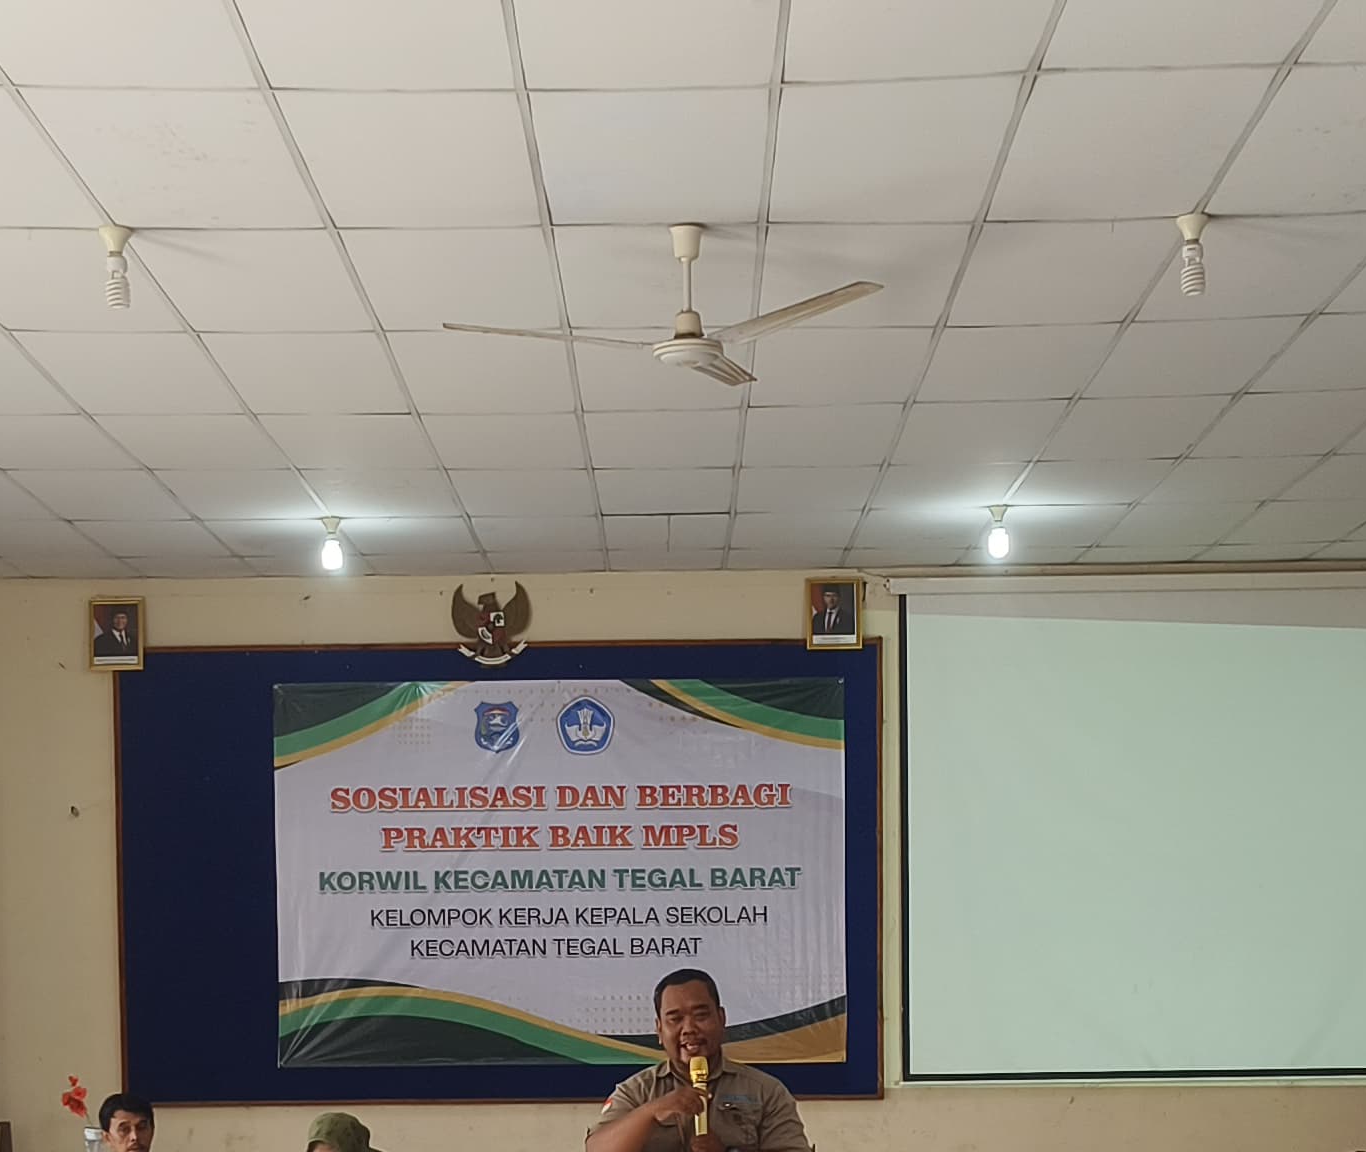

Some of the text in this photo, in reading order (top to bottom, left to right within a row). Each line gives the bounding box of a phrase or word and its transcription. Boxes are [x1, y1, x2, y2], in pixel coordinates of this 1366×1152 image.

[330, 783, 792, 812] SOSIALISASI DAN BERBAGI
[381, 823, 740, 851] PRAKTIK BAIK MPLS
[319, 867, 801, 893] KORWIL KECAMATAN TEGAL BARAT
[370, 906, 767, 927] KELOMPOK KERJA KEPALA SEKOLAH
[410, 937, 702, 958] KECAMATAN TEGAL BARAT
